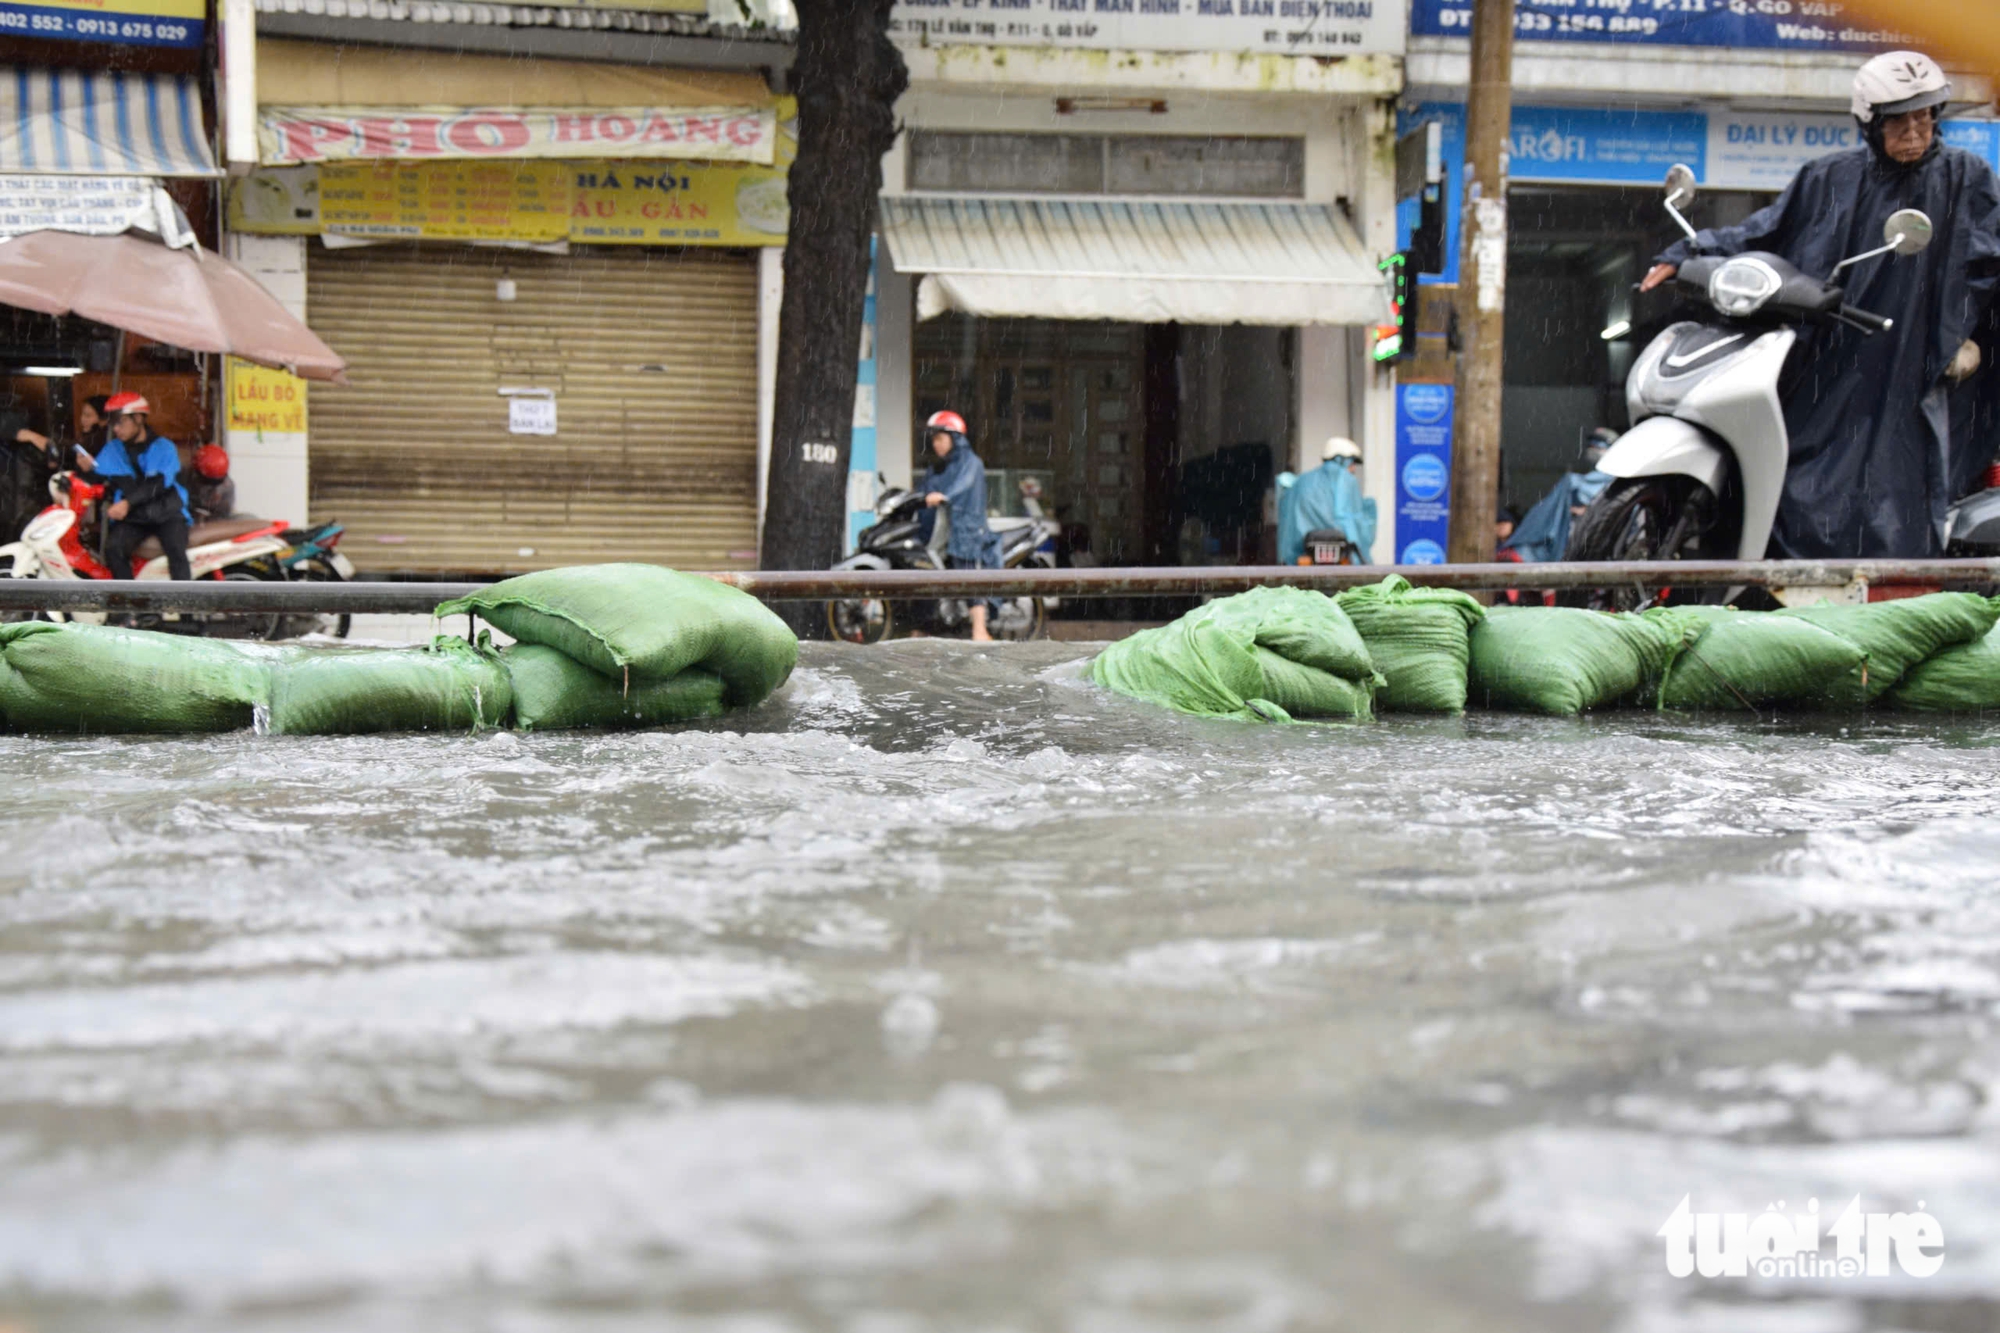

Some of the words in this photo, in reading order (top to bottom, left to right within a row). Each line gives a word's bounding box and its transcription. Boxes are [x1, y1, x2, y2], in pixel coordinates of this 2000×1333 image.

[31, 14, 63, 31] 552
[76, 18, 118, 36] 0913
[121, 22, 152, 38] 675
[155, 25, 187, 40] 029
[1776, 23, 1836, 42] Web:
[633, 172, 690, 193] NỘI
[802, 442, 837, 464] 180
